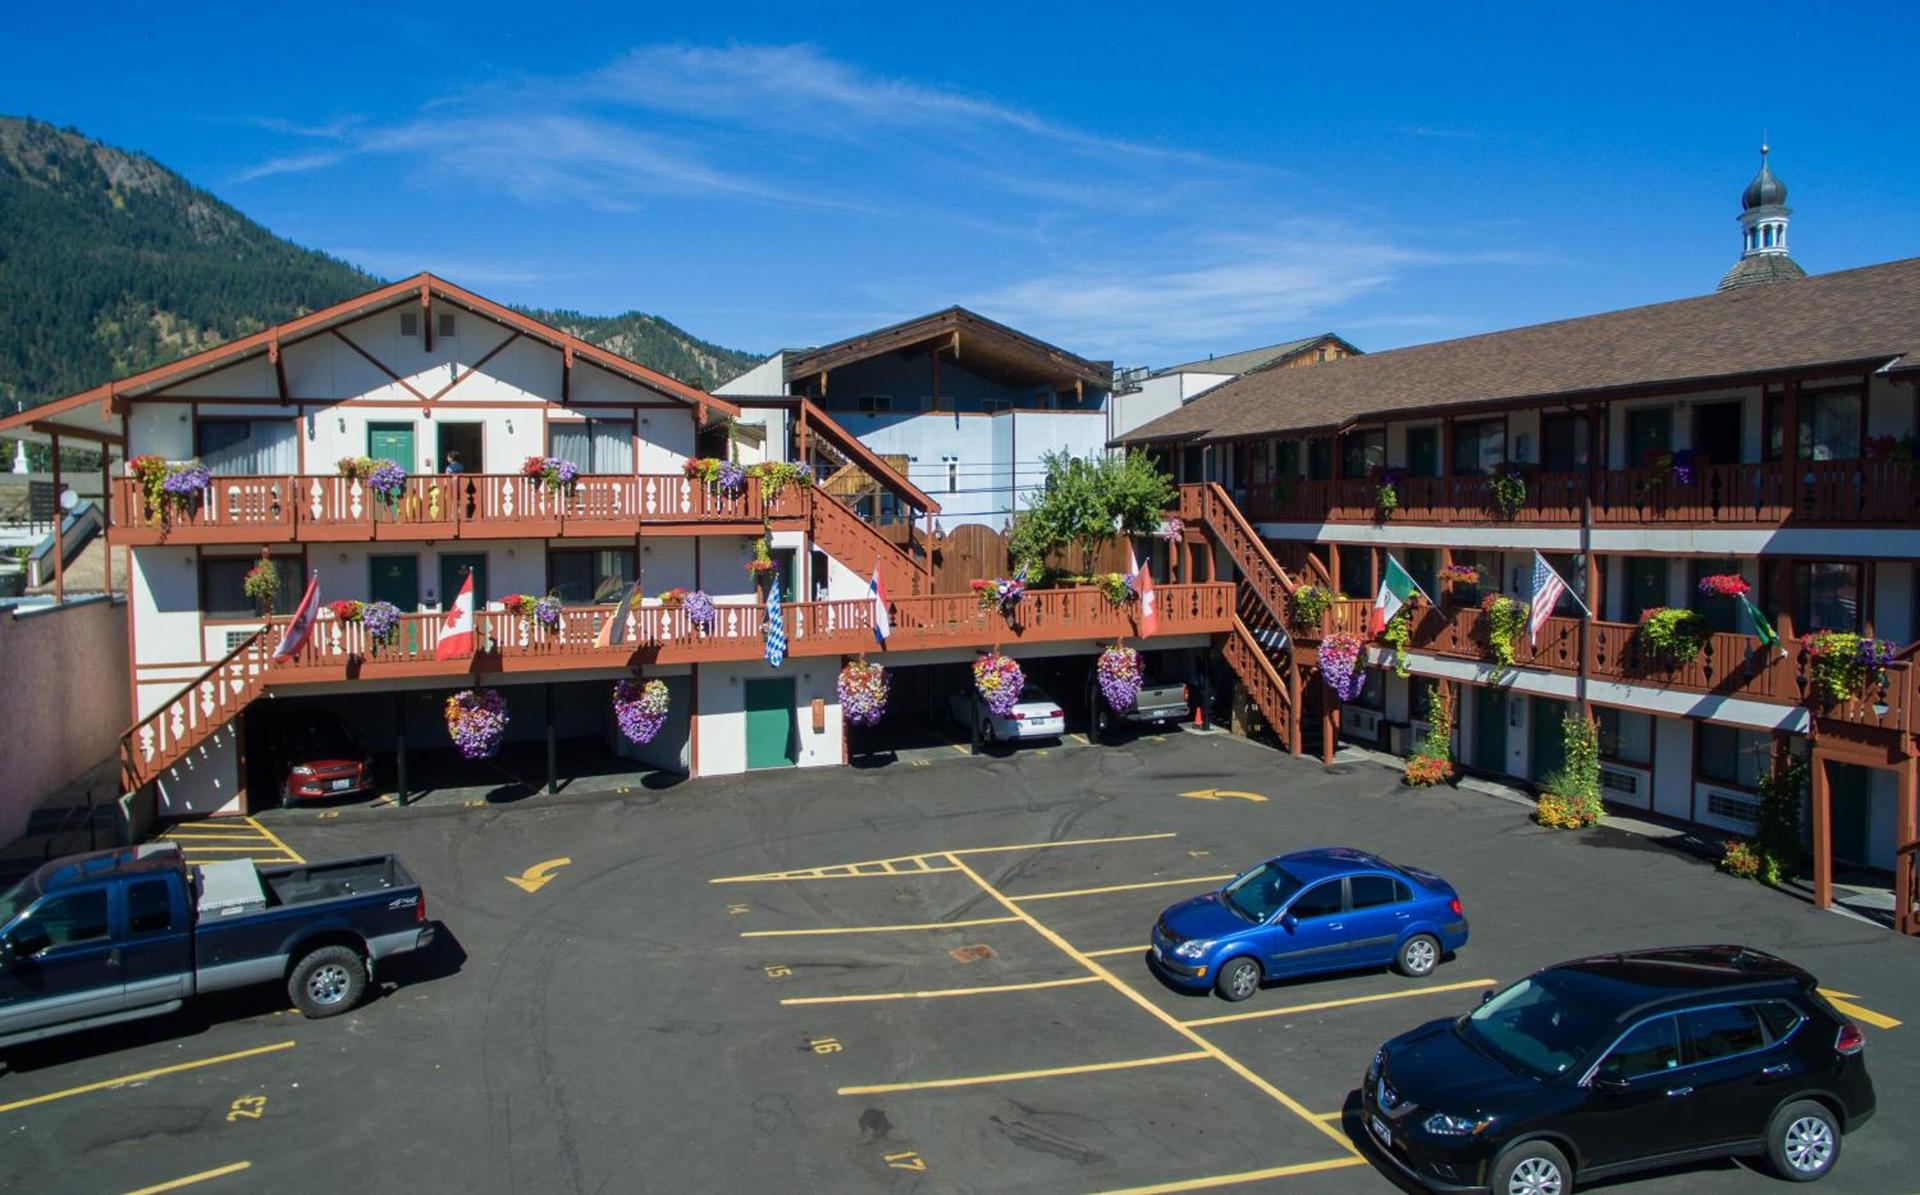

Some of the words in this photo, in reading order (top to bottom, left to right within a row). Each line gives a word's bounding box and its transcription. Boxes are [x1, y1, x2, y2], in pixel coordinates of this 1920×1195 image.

[764, 965, 792, 978] 15
[810, 1038, 842, 1053] 16
[226, 1096, 267, 1121] 23
[884, 1151, 927, 1171] 17
